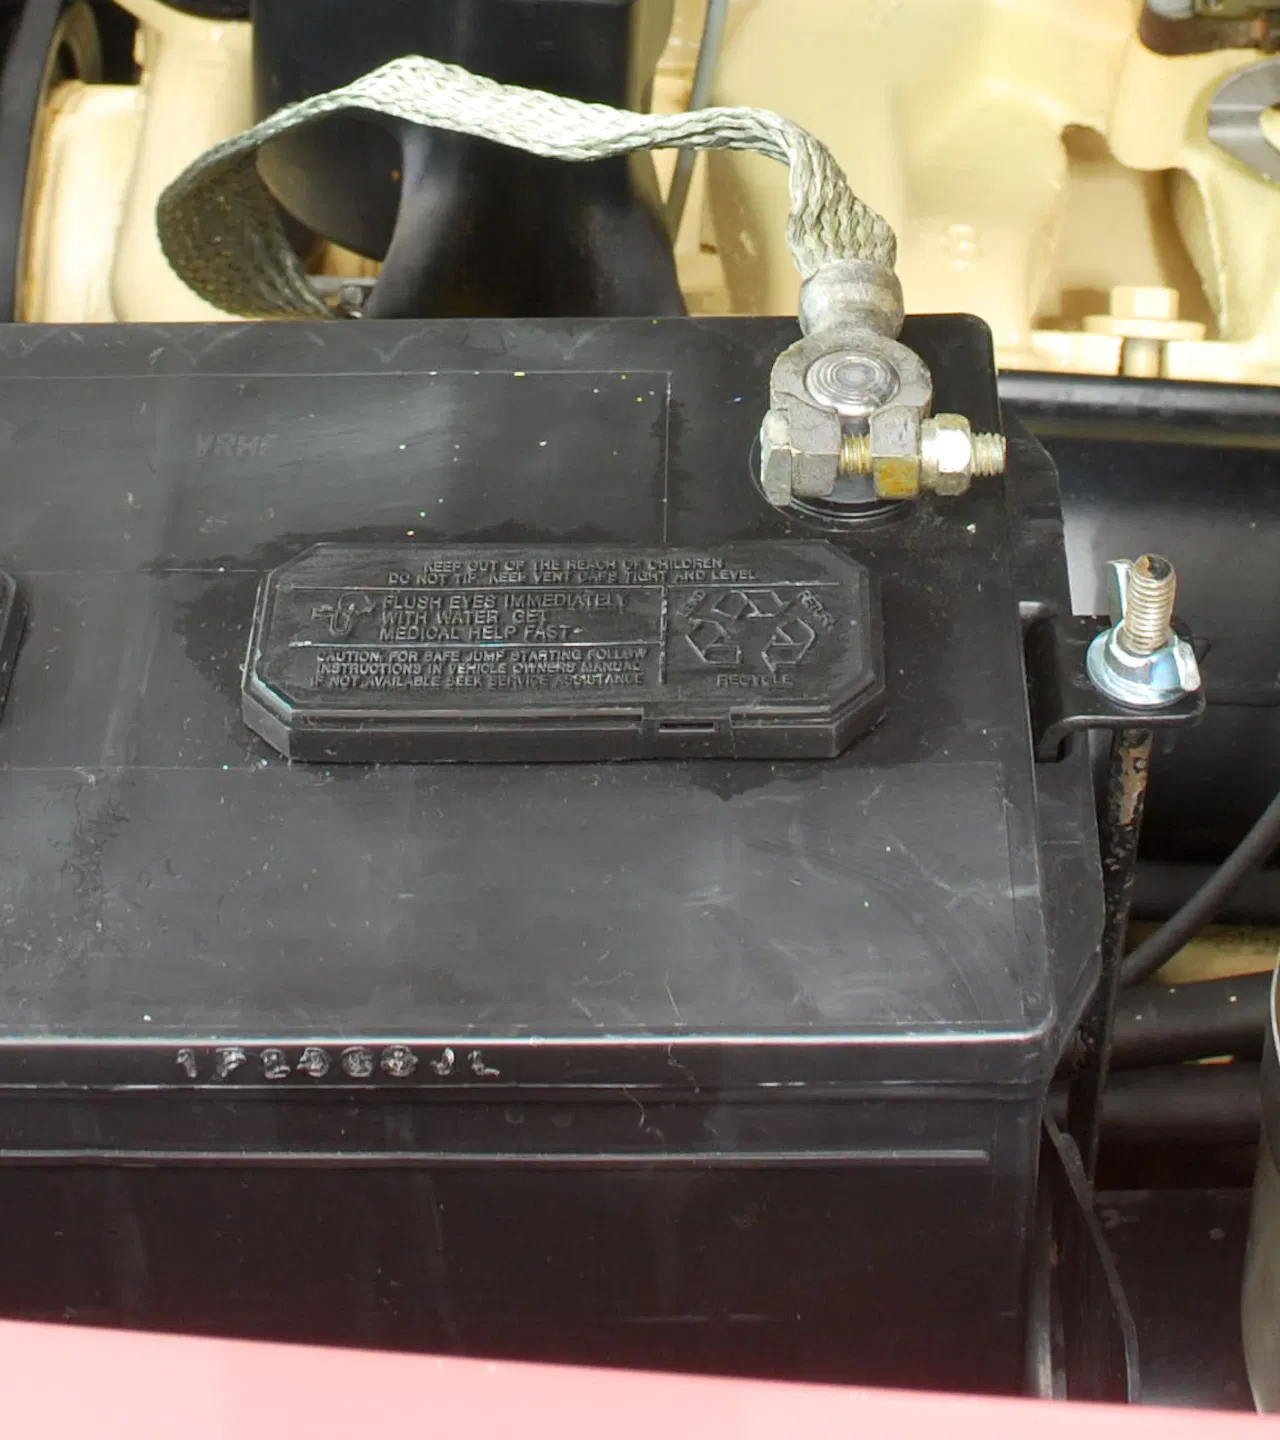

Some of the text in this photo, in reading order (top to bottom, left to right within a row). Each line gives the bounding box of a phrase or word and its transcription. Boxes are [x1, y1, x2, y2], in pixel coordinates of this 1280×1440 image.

[424, 557, 723, 573] KEEP OUT OF THE REACH OF CHILDREN
[387, 572, 410, 584] DO
[416, 572, 445, 584] NOT
[489, 572, 526, 584] KEEP
[533, 572, 570, 584] VENT
[578, 572, 617, 584] CAPS
[624, 572, 667, 584] TIGHT
[676, 569, 705, 582] AND
[711, 569, 757, 582] LEVEL
[382, 594, 628, 610] FLUSH EYES IMMEDIATELY
[381, 610, 427, 625] WITH
[379, 625, 460, 641] MEDICAL
[469, 625, 517, 641] HELP
[389, 650, 418, 662] FOR
[424, 650, 460, 662] SAFE
[467, 650, 505, 662] JUMP
[509, 650, 583, 662] STARTING
[588, 650, 647, 662] FOLLOW
[317, 662, 422, 675] INSTRUCTIONS
[428, 662, 443, 675] IN
[448, 662, 508, 675] VEHICLE
[310, 675, 646, 687] IF NOT AVAILABLE SEEK SERVICE ASSISTANCE
[716, 673, 794, 687] RECYCLE
